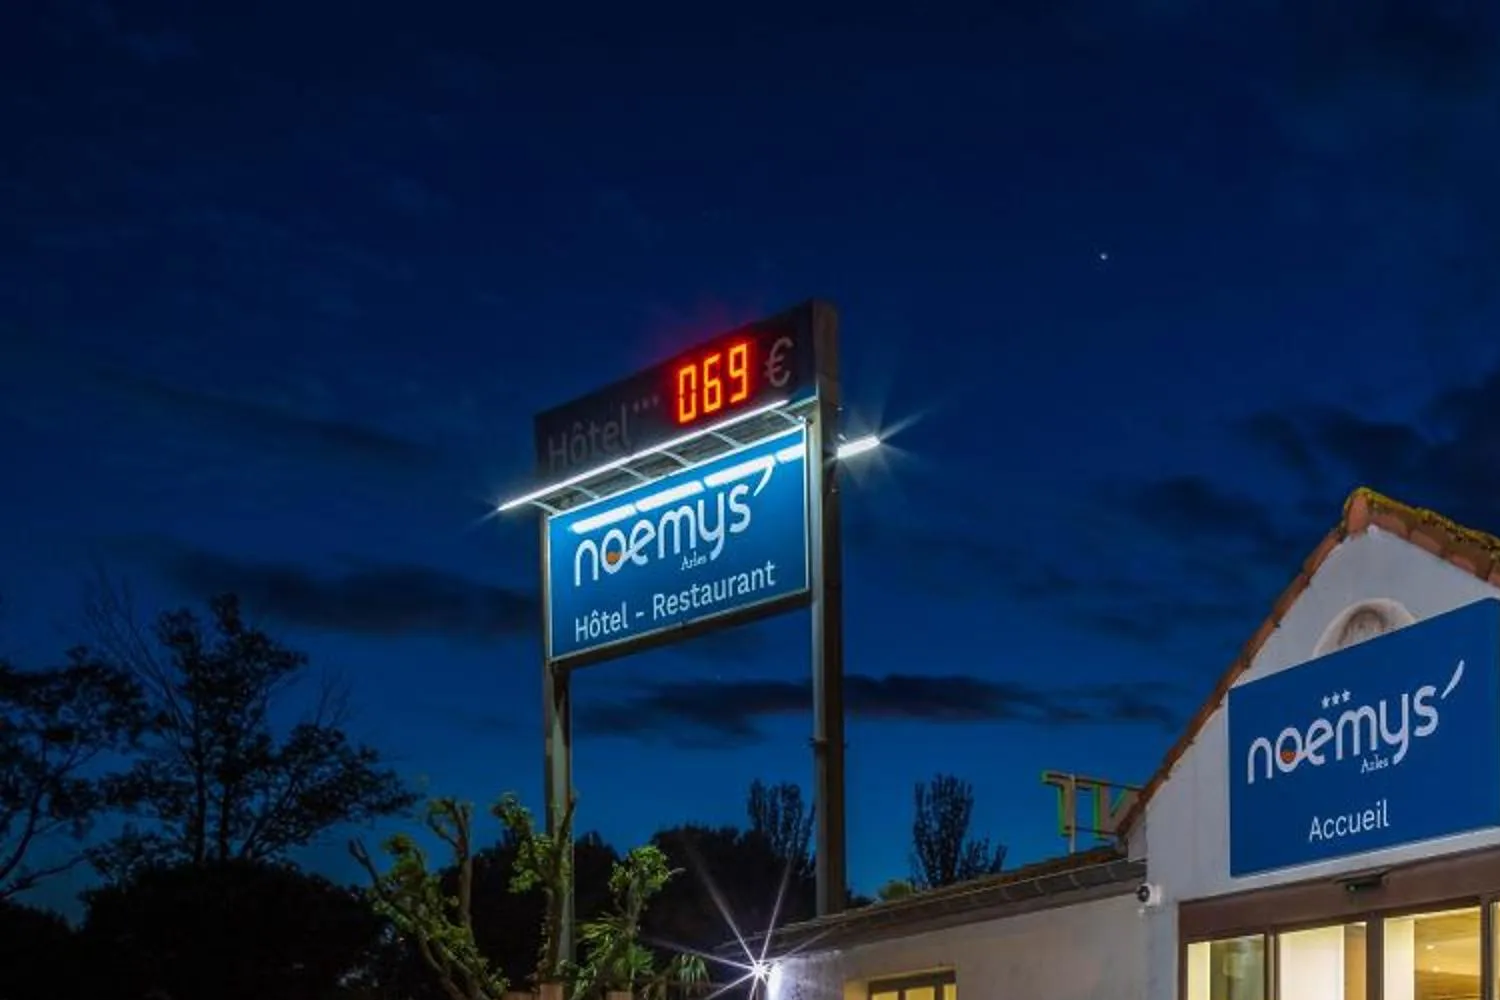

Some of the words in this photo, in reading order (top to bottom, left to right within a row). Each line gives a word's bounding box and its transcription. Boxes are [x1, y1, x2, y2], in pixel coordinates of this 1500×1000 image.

[548, 402, 631, 472] Hôtel
[678, 343, 748, 423] 069
[574, 602, 629, 642] Hôtel
[653, 561, 775, 620] Restaurant
[1308, 799, 1389, 842] Accueil
